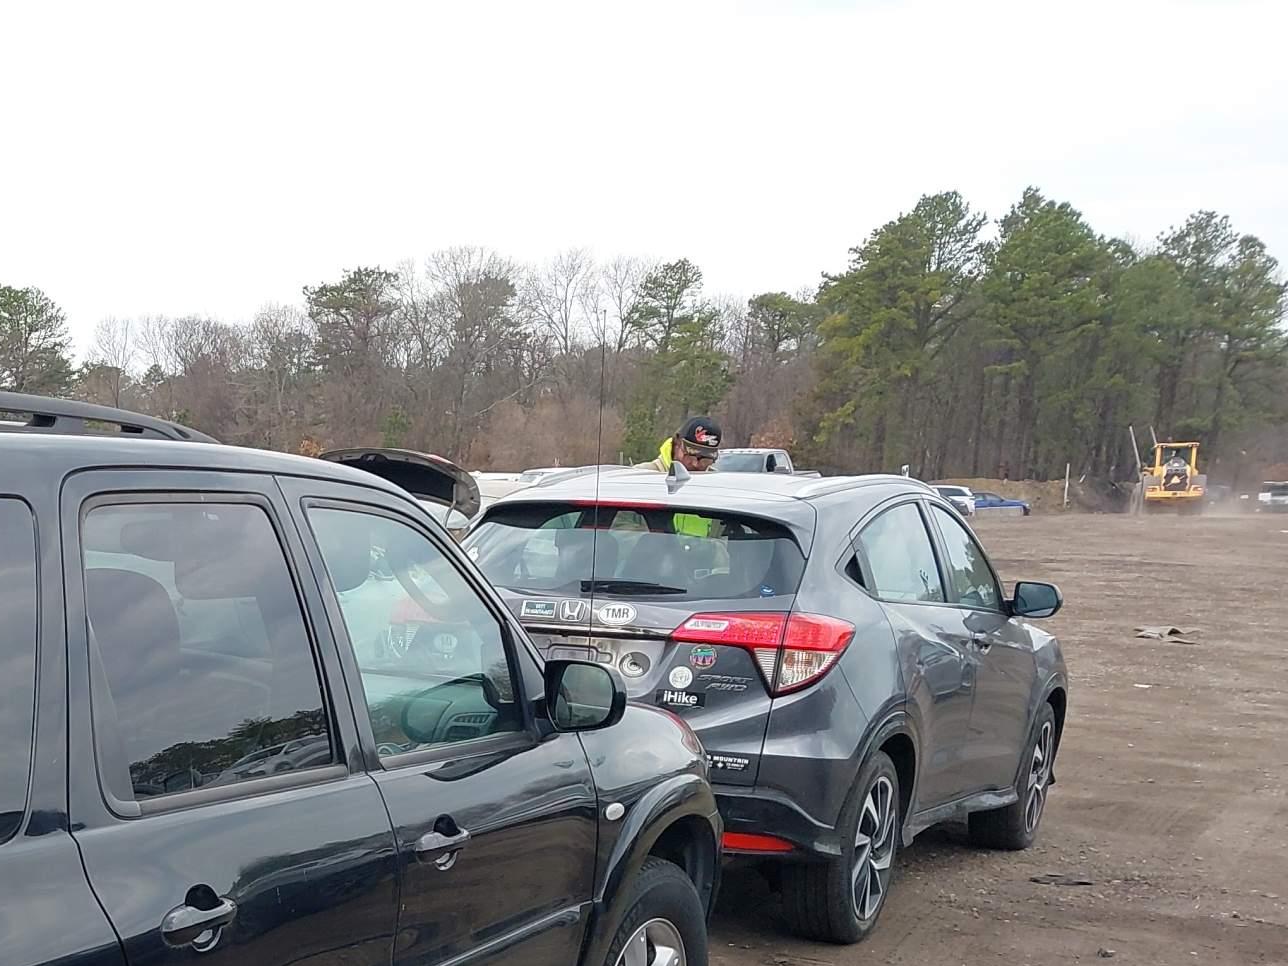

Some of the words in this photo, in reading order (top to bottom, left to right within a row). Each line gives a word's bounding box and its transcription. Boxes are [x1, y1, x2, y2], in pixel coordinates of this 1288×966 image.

[605, 607, 630, 619] TMR
[697, 674, 754, 684] SPORT
[705, 682, 748, 692] AWD
[662, 690, 698, 704] iHike
[713, 755, 749, 765] MOUNTAIN
